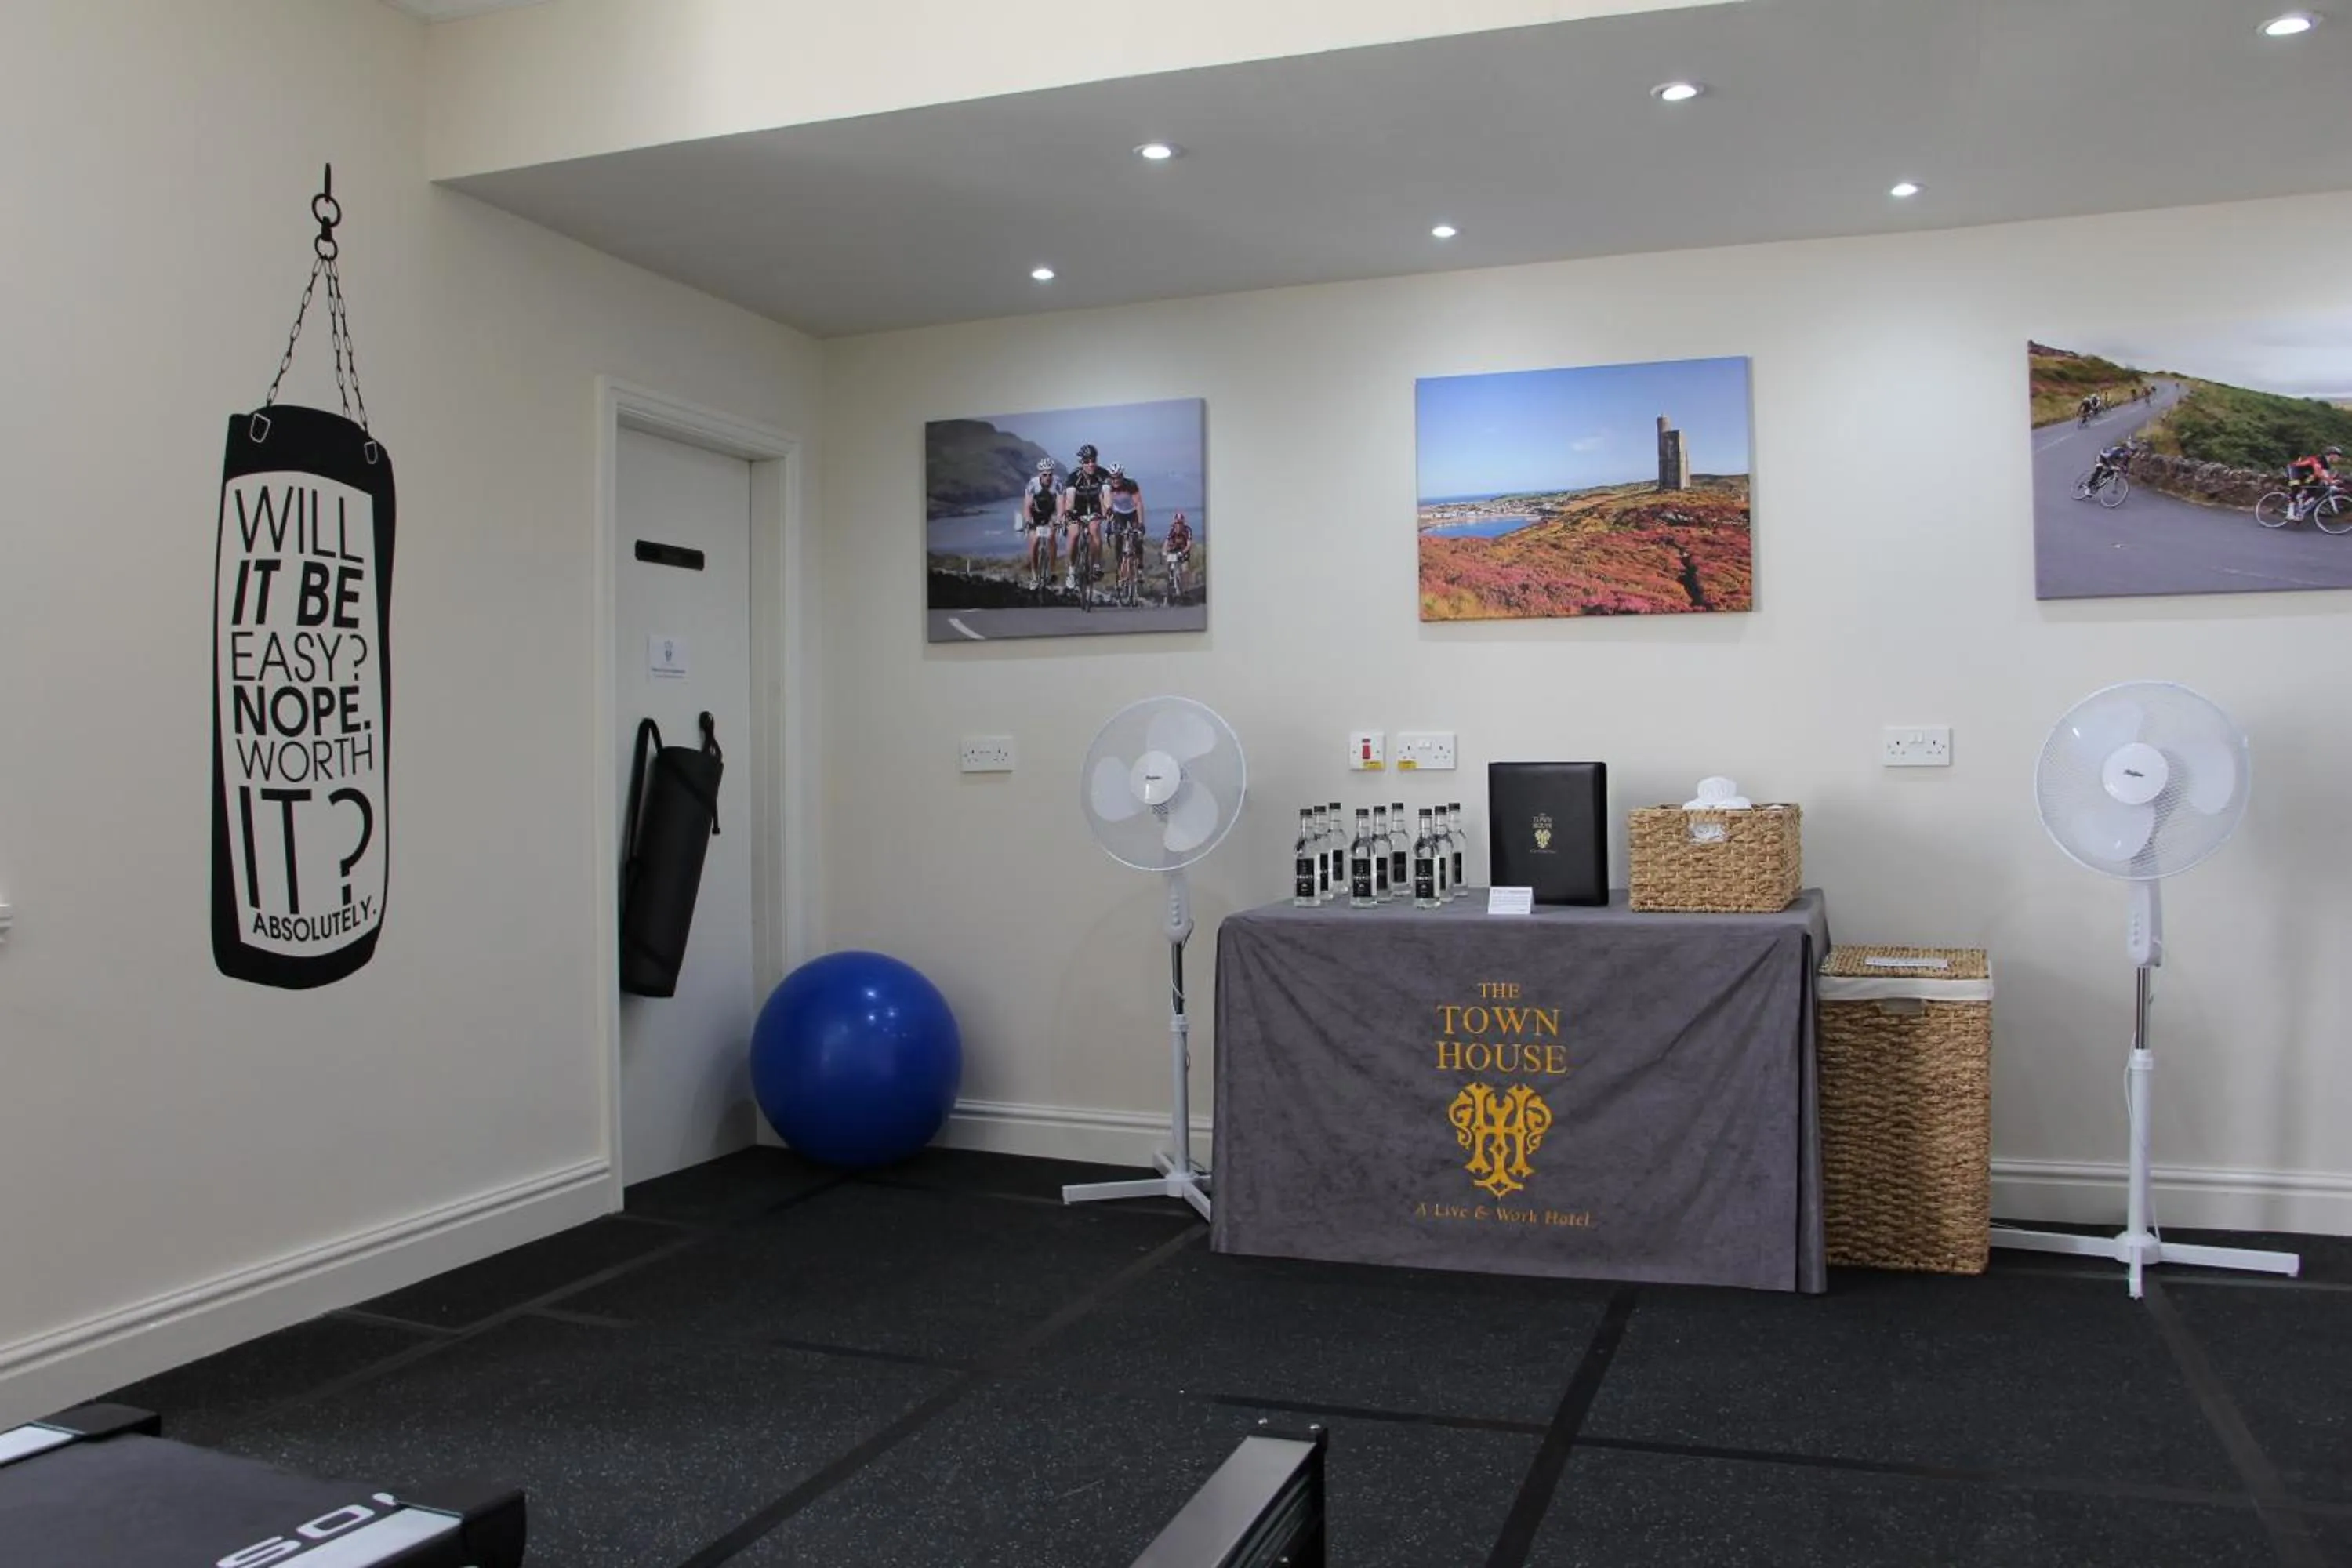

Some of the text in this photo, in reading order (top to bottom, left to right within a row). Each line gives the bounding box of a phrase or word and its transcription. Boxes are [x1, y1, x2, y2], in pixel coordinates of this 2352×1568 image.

[235, 485, 364, 563] WILL
[231, 559, 364, 629] IT BE
[231, 631, 367, 682] EASY?
[233, 685, 371, 737] NOPE.
[236, 734, 372, 782] WORTH
[239, 785, 373, 915] IT?
[252, 895, 377, 942] ABSOLUTELY.
[1477, 982, 1521, 999] THE
[1436, 1006, 1563, 1037] TOWN
[1436, 1040, 1568, 1075] HOUSE
[1415, 1202, 1591, 1227] A Live & Work Hotel
